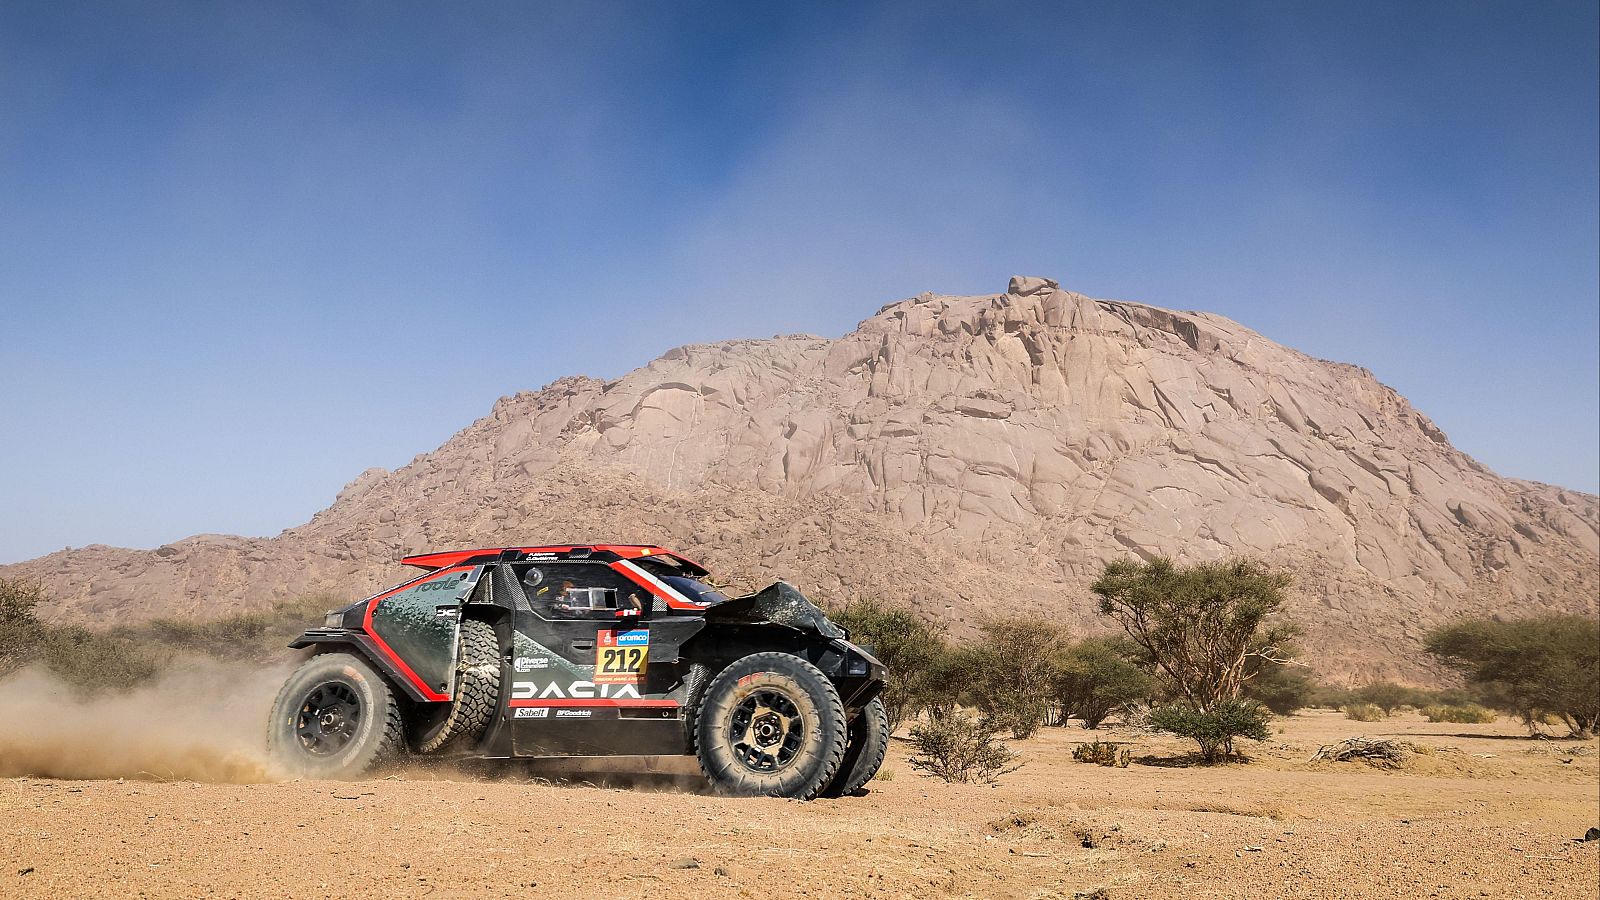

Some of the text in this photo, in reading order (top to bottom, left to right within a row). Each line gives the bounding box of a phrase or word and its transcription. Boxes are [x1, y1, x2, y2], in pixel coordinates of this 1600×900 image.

[521, 656, 549, 664] Diverse
[602, 648, 641, 673] 212
[511, 680, 642, 699] DACIA
[518, 707, 545, 717] Sabelt
